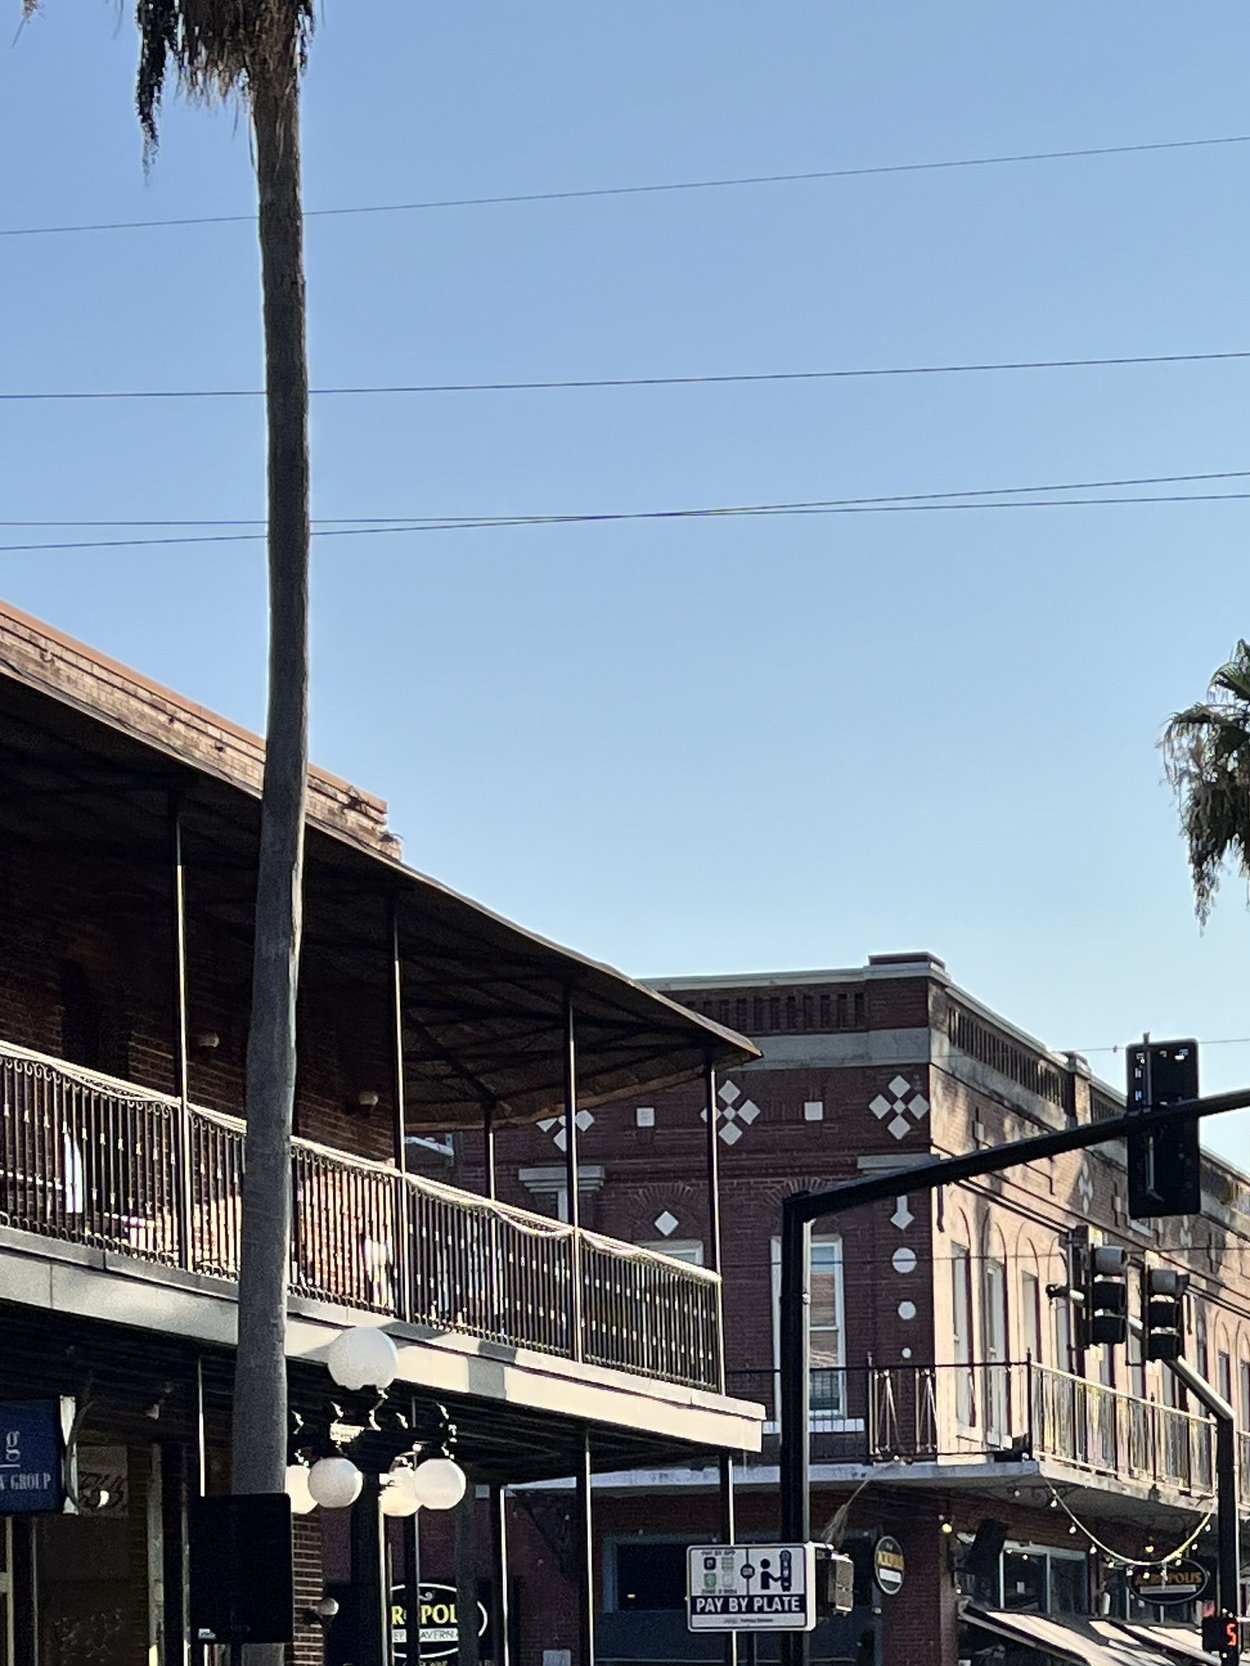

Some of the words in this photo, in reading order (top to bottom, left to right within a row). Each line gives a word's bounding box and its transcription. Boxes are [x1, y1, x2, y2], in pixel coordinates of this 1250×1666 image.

[10, 1473, 51, 1490] GROUP
[696, 1598, 723, 1612] PAY
[729, 1597, 749, 1611] BY
[754, 1597, 800, 1611] PLATE
[421, 1630, 458, 1642] AVERN
